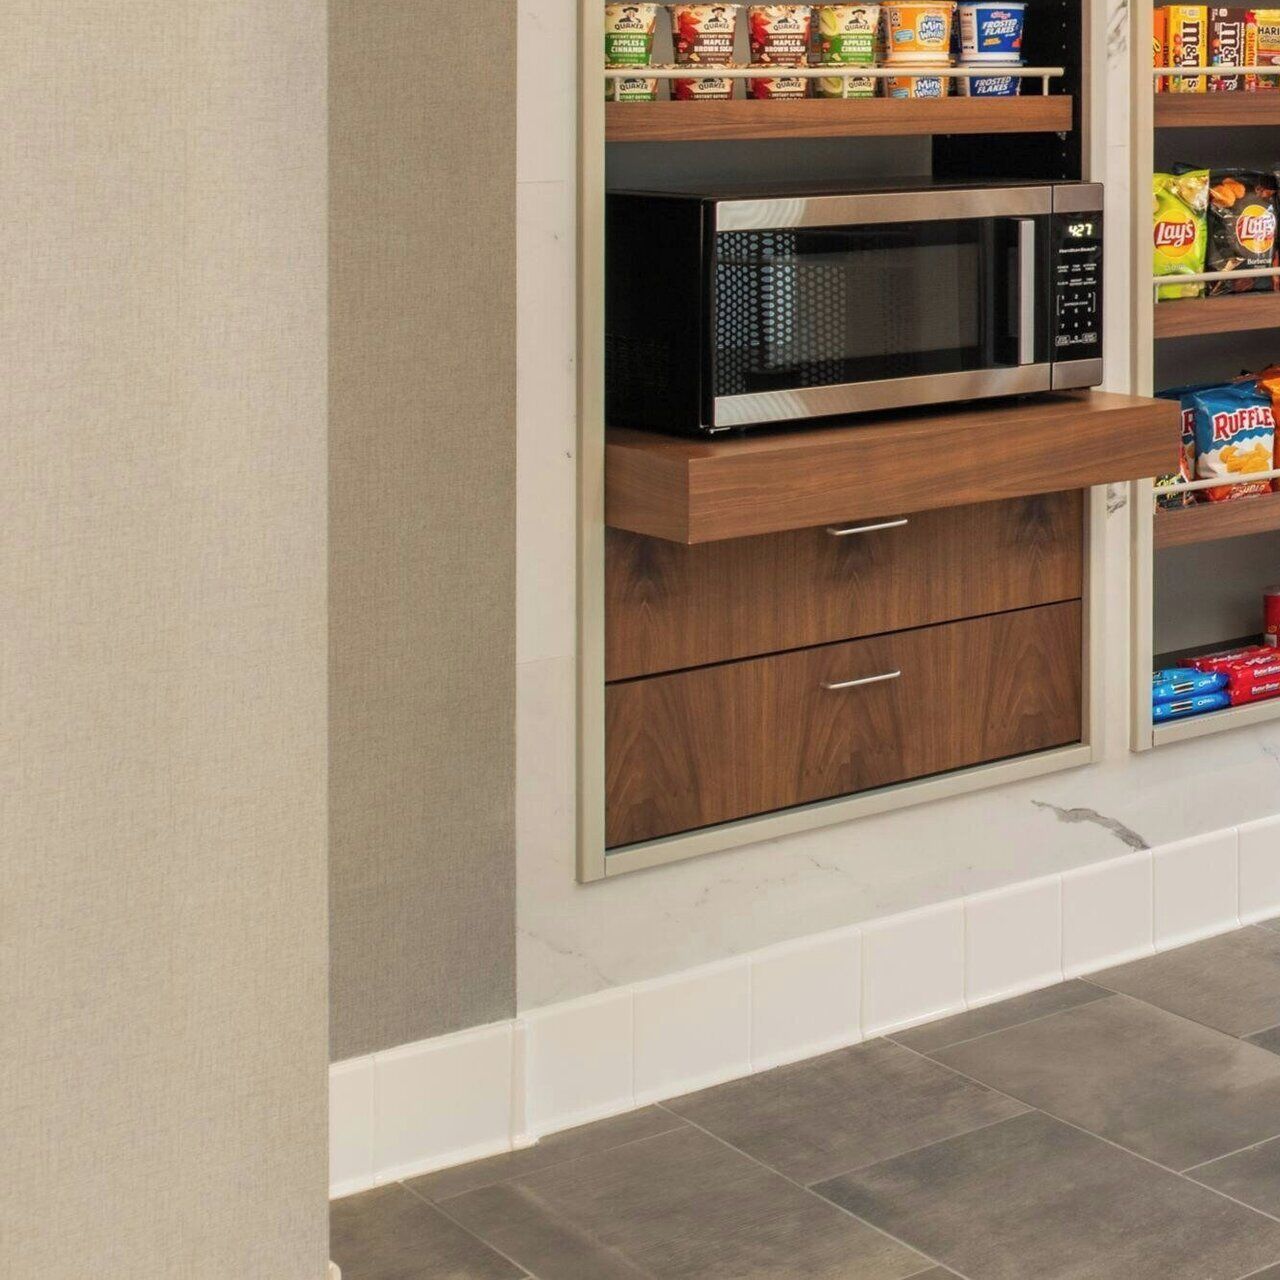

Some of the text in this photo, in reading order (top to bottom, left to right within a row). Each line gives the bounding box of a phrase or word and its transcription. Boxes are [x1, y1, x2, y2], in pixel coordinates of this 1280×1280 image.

[704, 22, 730, 30] QUAKER
[982, 19, 1018, 29] FROSTED
[985, 27, 1014, 36] FLAKES
[698, 82, 726, 90] QUAKER
[975, 76, 1012, 87] FROSTED
[620, 83, 649, 91] QUAKER
[977, 84, 1008, 94] FLAKES
[1241, 214, 1275, 241] Lay's
[1156, 220, 1194, 247] Lay's
[1213, 407, 1274, 439] RUFFLE
